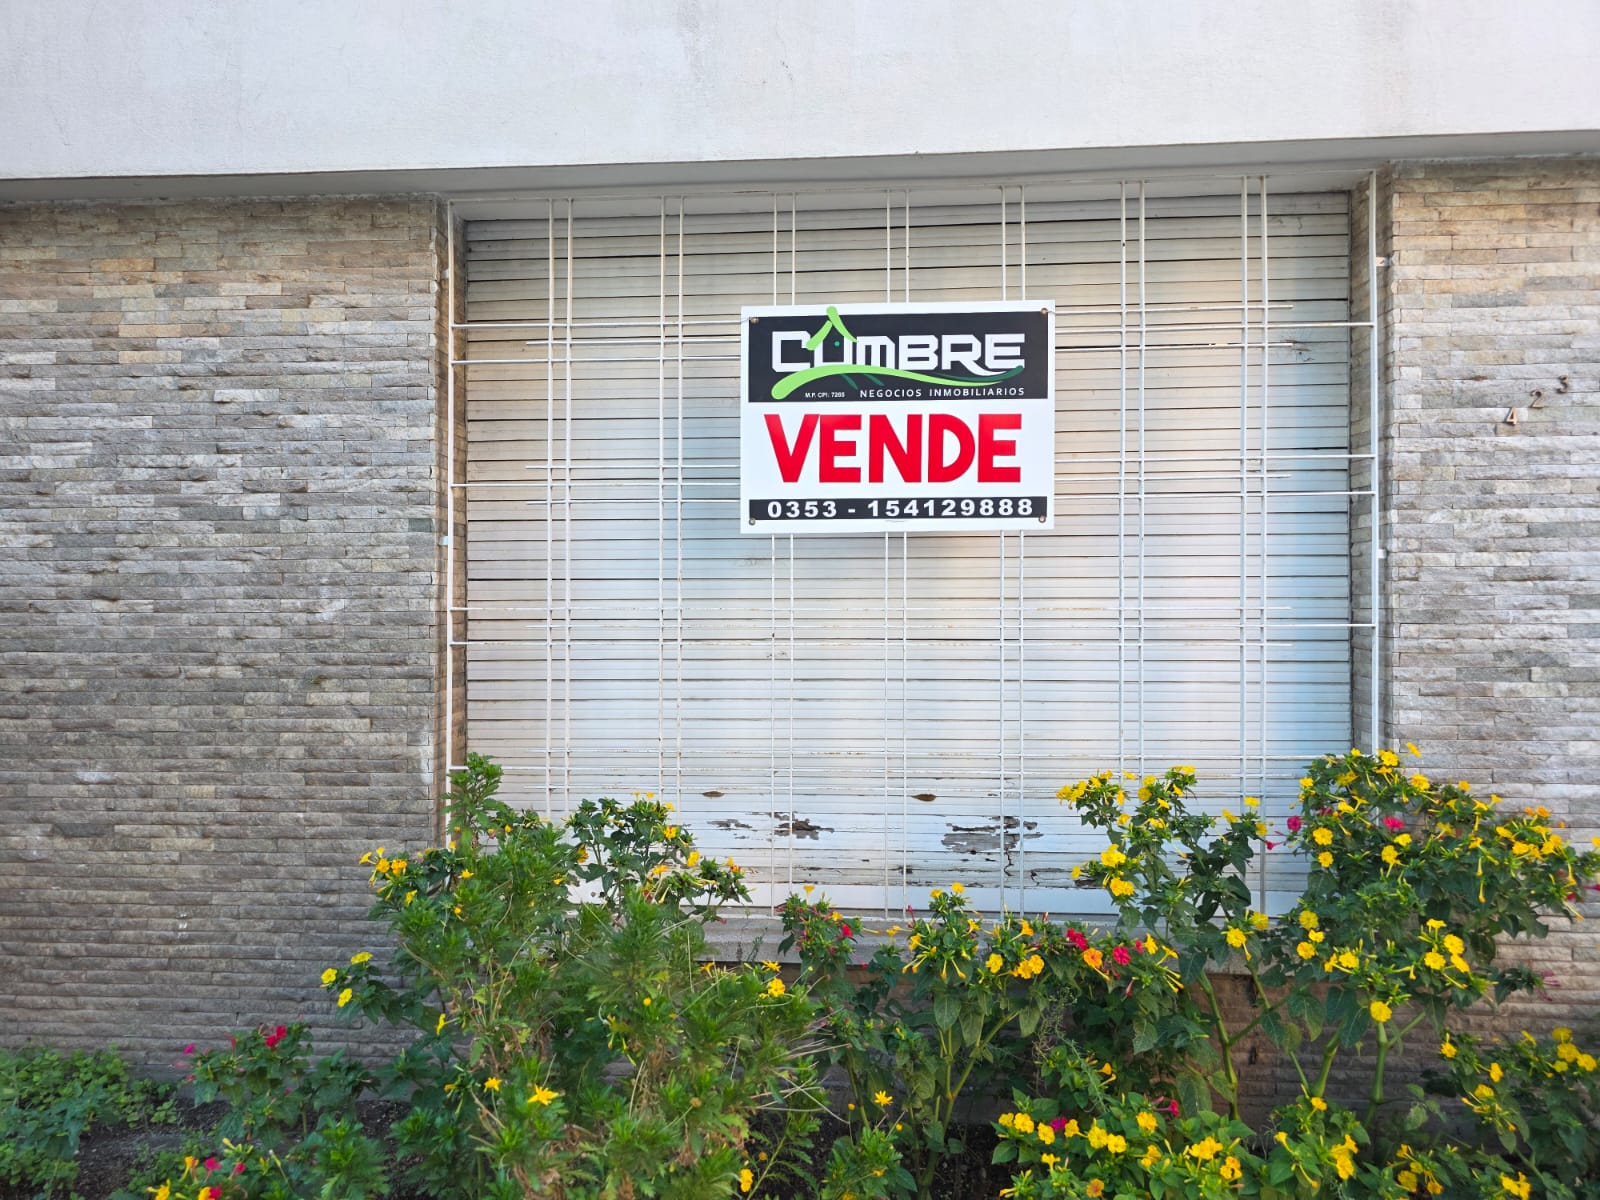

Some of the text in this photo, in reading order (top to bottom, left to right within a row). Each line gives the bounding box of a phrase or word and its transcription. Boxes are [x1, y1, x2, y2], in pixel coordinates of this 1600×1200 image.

[771, 331, 1026, 376] CUMBRE
[859, 387, 1025, 398] NEGOCIOS INMOBILIARIOS
[763, 413, 1022, 483] VENDE
[767, 501, 837, 518] 0353
[867, 499, 1033, 517] 154129888
